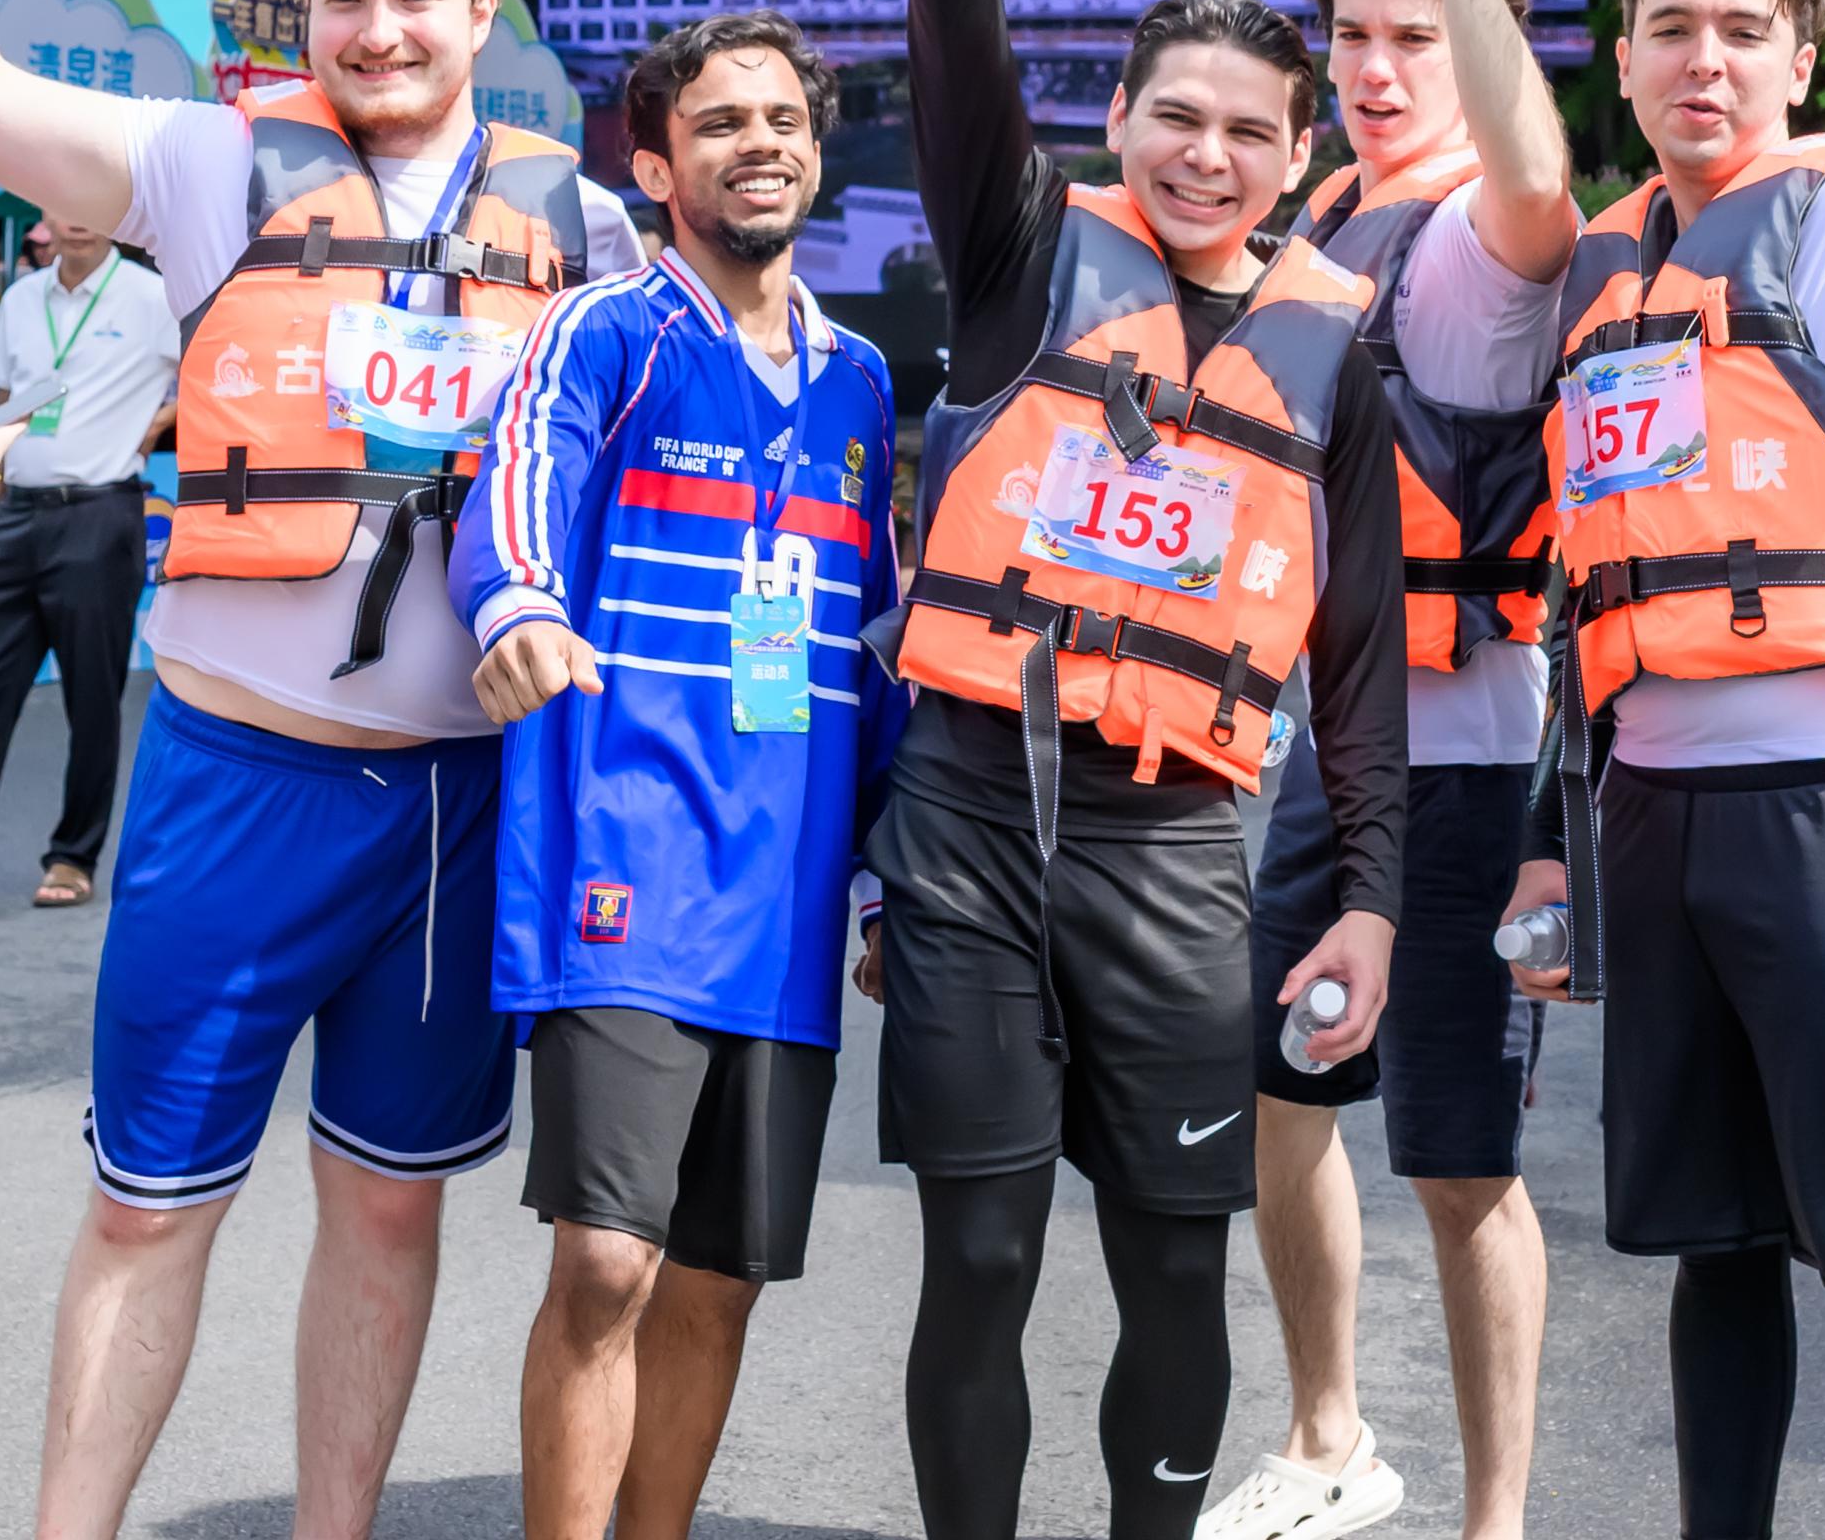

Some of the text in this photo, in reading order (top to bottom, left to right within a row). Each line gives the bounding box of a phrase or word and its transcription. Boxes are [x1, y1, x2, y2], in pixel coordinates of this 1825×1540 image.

[365, 351, 471, 419] 041
[654, 436, 744, 462] FIFA WORLD CUP
[661, 453, 734, 477] FRANCE 98
[1581, 398, 1660, 473] 157
[1073, 481, 1192, 558] 153
[1240, 540, 1289, 599] 峡
[751, 664, 790, 681] 运动员
